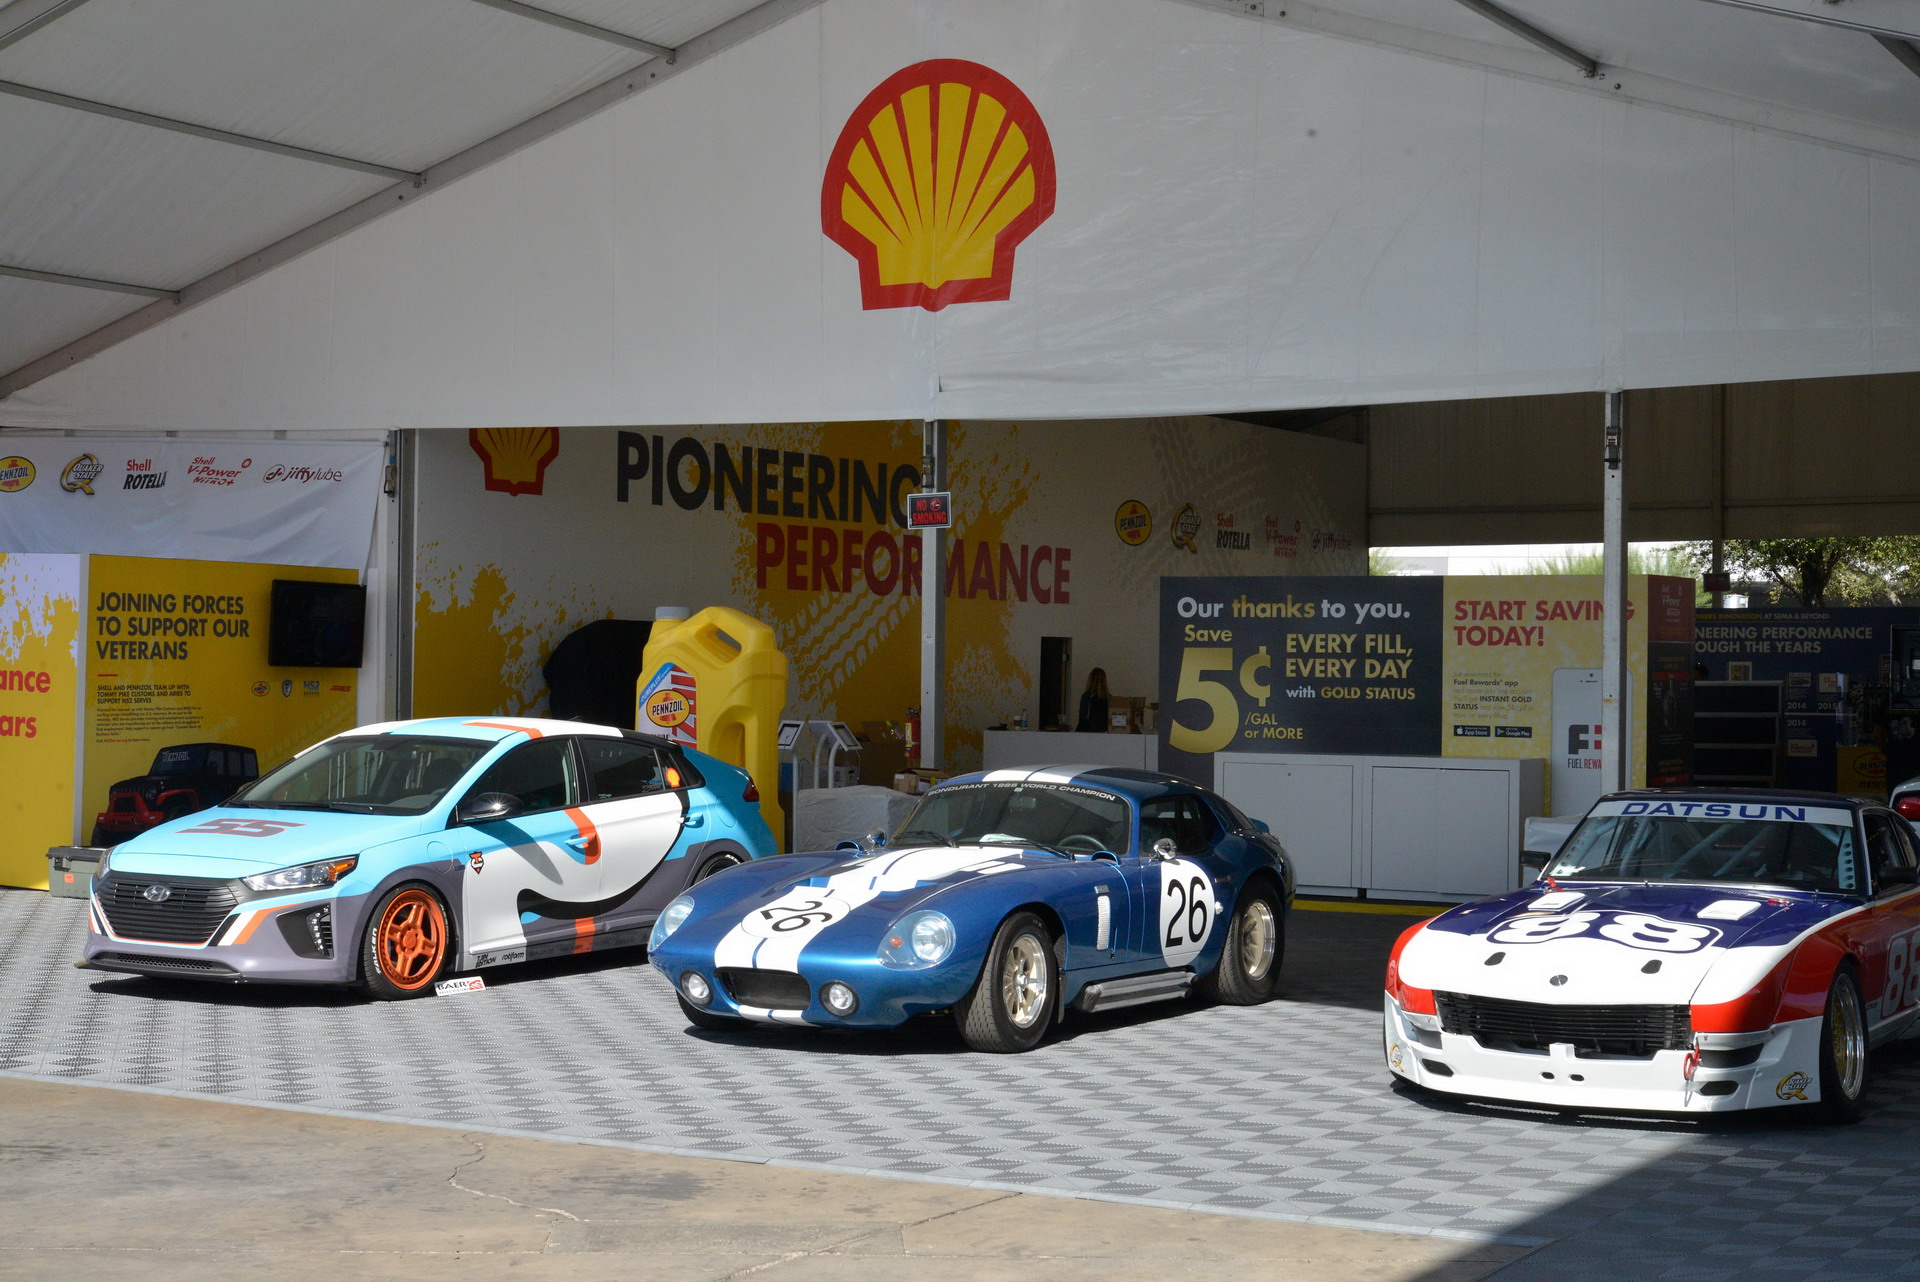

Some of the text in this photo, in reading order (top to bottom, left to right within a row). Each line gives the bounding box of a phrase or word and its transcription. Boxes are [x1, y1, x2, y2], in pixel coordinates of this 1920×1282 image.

[73, 463, 104, 472] QUAKER
[126, 459, 151, 471] Shell
[192, 457, 215, 465] Shell
[74, 471, 97, 480] STATE
[123, 471, 168, 490] ROTELLA
[187, 466, 242, 478] V-Power
[916, 499, 927, 511] NO
[912, 512, 947, 525] SMOKING
[1119, 515, 1148, 532] PENNZOIL
[1216, 513, 1234, 528] Shell
[1216, 530, 1250, 550] ROTELLA
[1265, 529, 1298, 546] V-Power
[756, 522, 1071, 604] PERFORMANCE
[97, 592, 243, 614] JOINING FORCES
[1177, 595, 1410, 624] Our thanks to you.
[1454, 600, 1527, 621] START
[97, 616, 249, 637] TO SUPPORT OUR
[1184, 624, 1232, 642] Save
[1695, 627, 1757, 639] NEERING
[1762, 627, 1873, 639] PERFORMANCE
[1454, 626, 1544, 647] TODAY!
[96, 641, 188, 660] VETERANS
[1286, 634, 1413, 657] EVERY FILL,
[1695, 641, 1821, 653] OUGH THE YEARS
[1286, 659, 1413, 679] EVERY DAY
[1286, 685, 1415, 700] with GOLD STATUS
[652, 700, 684, 717] PENNZOIL
[1787, 702, 1807, 710] 2014
[1244, 712, 1278, 725] /GAL
[1787, 719, 1807, 727] 2014
[1244, 728, 1303, 739] or MORE
[1567, 758, 1583, 769] FUEL
[928, 783, 990, 797] BONDURANT
[1059, 785, 1116, 801] CHAMPION
[1620, 802, 1806, 821] DATSUN
[760, 901, 833, 932] 26
[1165, 876, 1208, 948] 26
[1493, 912, 1710, 953] 88
[437, 981, 467, 991] BAER
